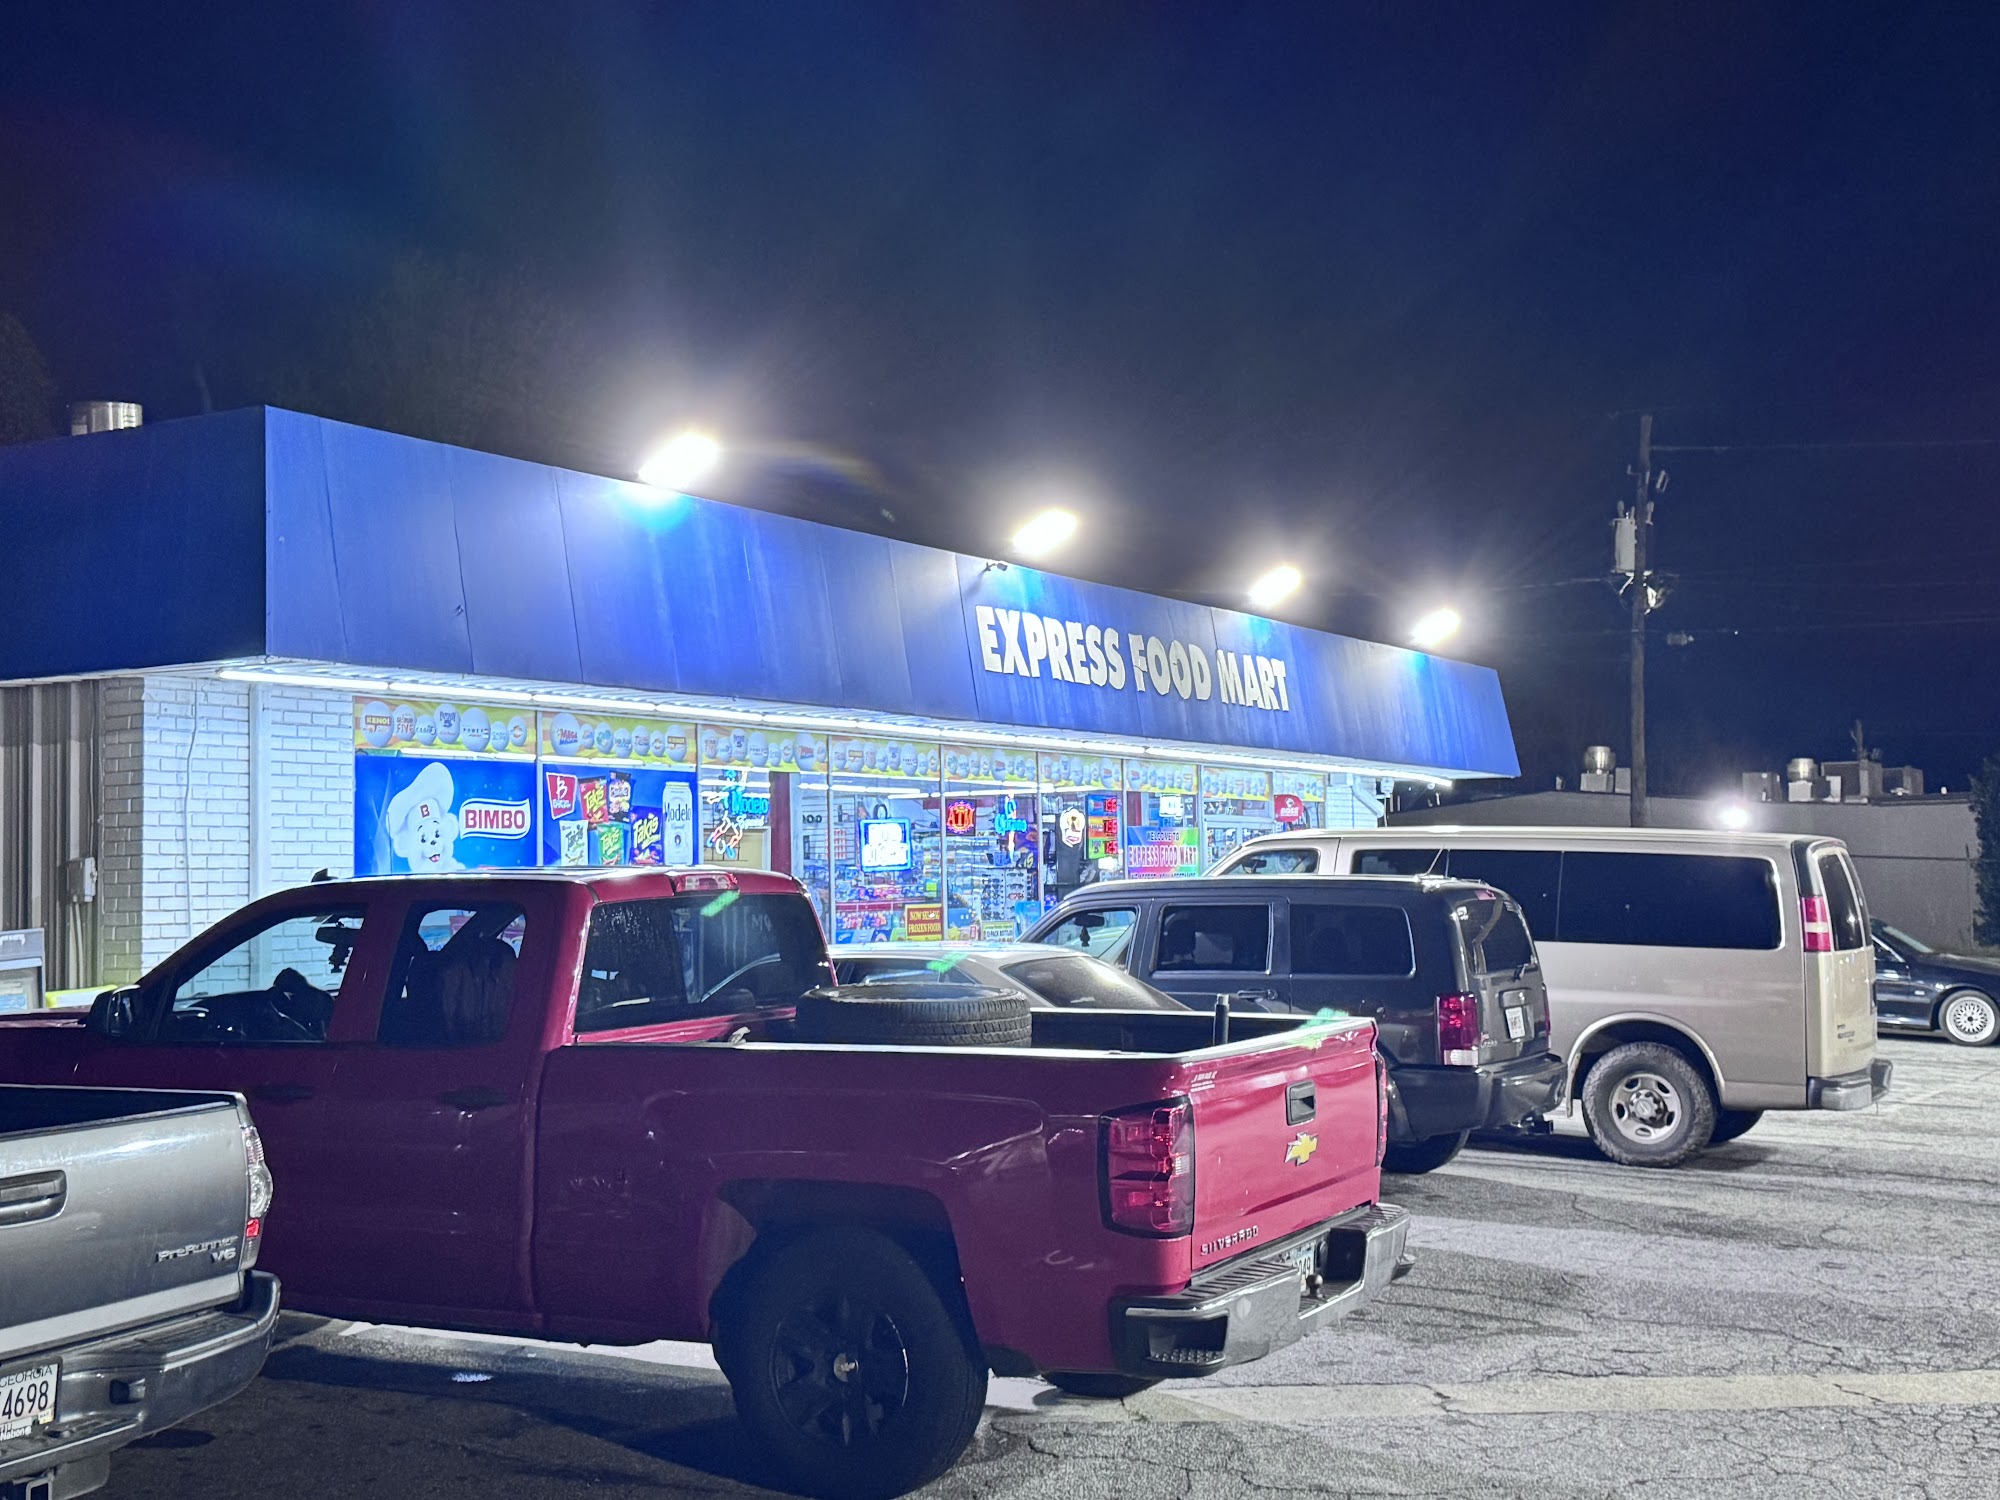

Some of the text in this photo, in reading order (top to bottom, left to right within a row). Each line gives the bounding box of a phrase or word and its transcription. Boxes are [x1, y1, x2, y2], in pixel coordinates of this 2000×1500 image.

[976, 605, 1290, 711] EXPRESS FOOD MART
[465, 809, 525, 829] BIMBO
[948, 807, 973, 827] ATM
[633, 814, 659, 849] Takis
[1128, 845, 1197, 867] EXPRESS FOOD MART
[157, 1235, 239, 1263] PreRunner
[211, 1247, 237, 1262] V6
[1200, 1225, 1260, 1256] SILVERADO
[0, 1380, 49, 1420] 4698
